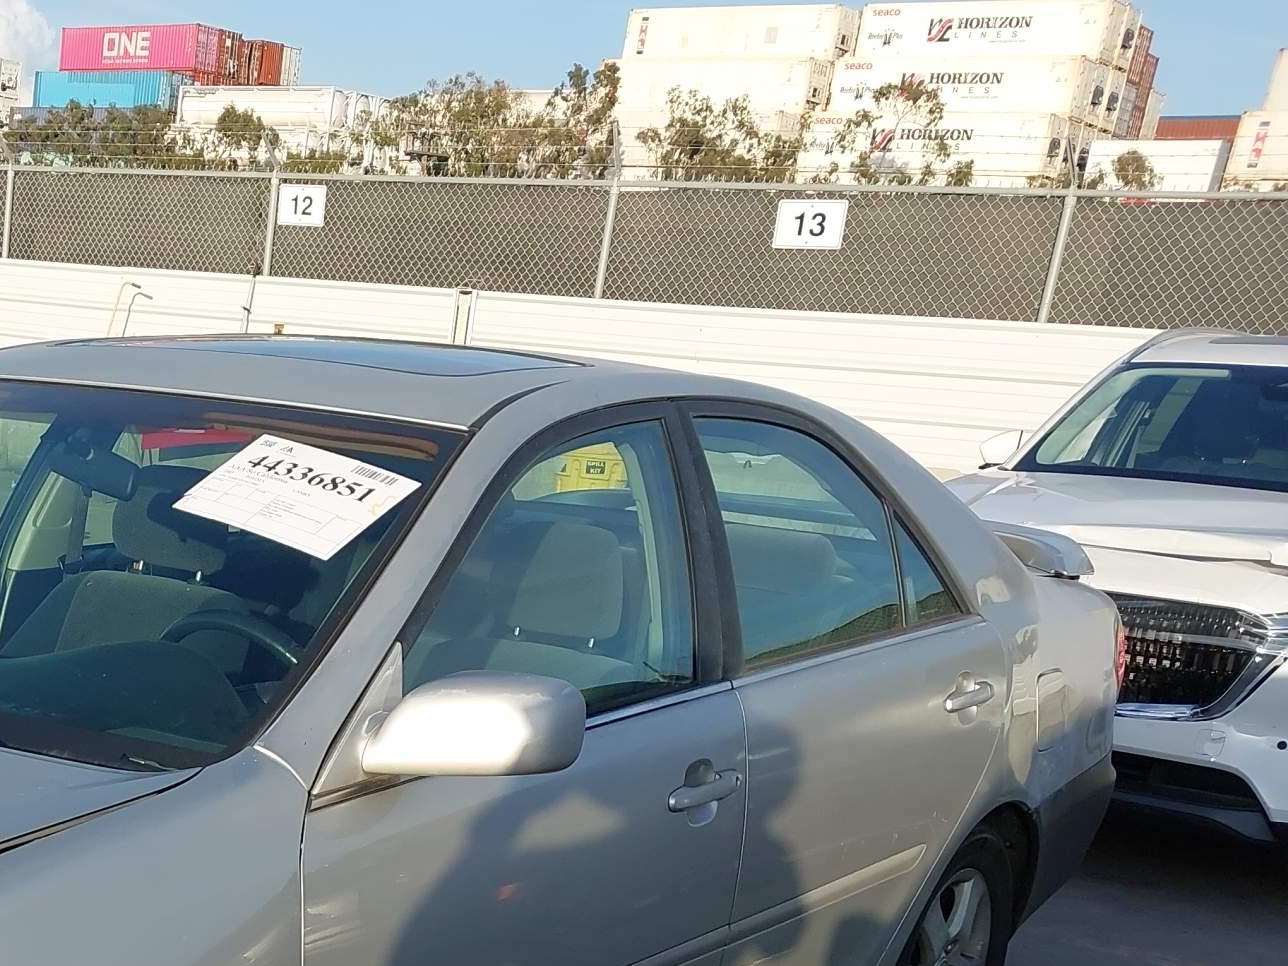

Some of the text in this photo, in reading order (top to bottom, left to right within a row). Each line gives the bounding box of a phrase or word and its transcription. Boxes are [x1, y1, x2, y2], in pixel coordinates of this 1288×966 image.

[872, 8, 901, 17] seaco
[956, 15, 1034, 30] HORIZON
[954, 30, 1019, 39] LINES
[102, 31, 152, 57] ONE
[844, 61, 873, 71] seaco
[928, 72, 1004, 85] HORIZON
[938, 86, 990, 94] INES
[814, 117, 843, 125] seaco
[899, 128, 974, 141] HORIZON
[896, 142, 961, 150] LINS
[291, 194, 313, 216] 12
[794, 211, 827, 237] 13
[248, 455, 376, 503] 44336851
